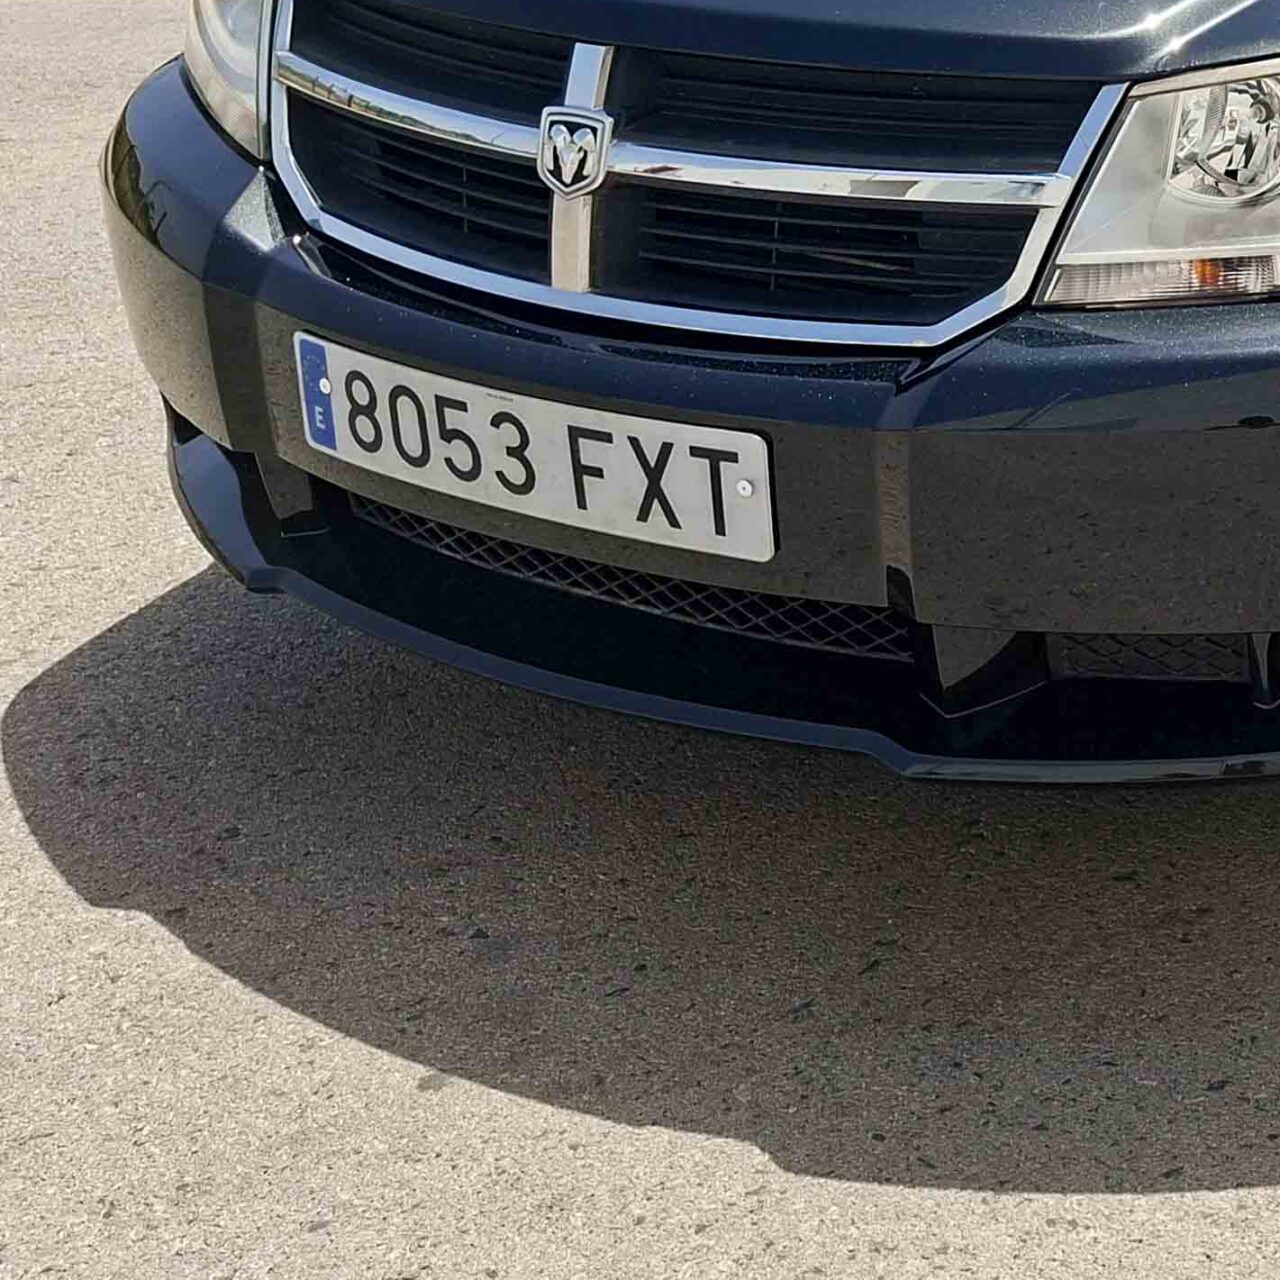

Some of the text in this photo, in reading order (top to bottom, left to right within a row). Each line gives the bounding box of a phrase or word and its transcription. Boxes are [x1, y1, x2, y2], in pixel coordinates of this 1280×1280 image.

[314, 405, 327, 430] E
[344, 369, 740, 537] 8053 FXT
